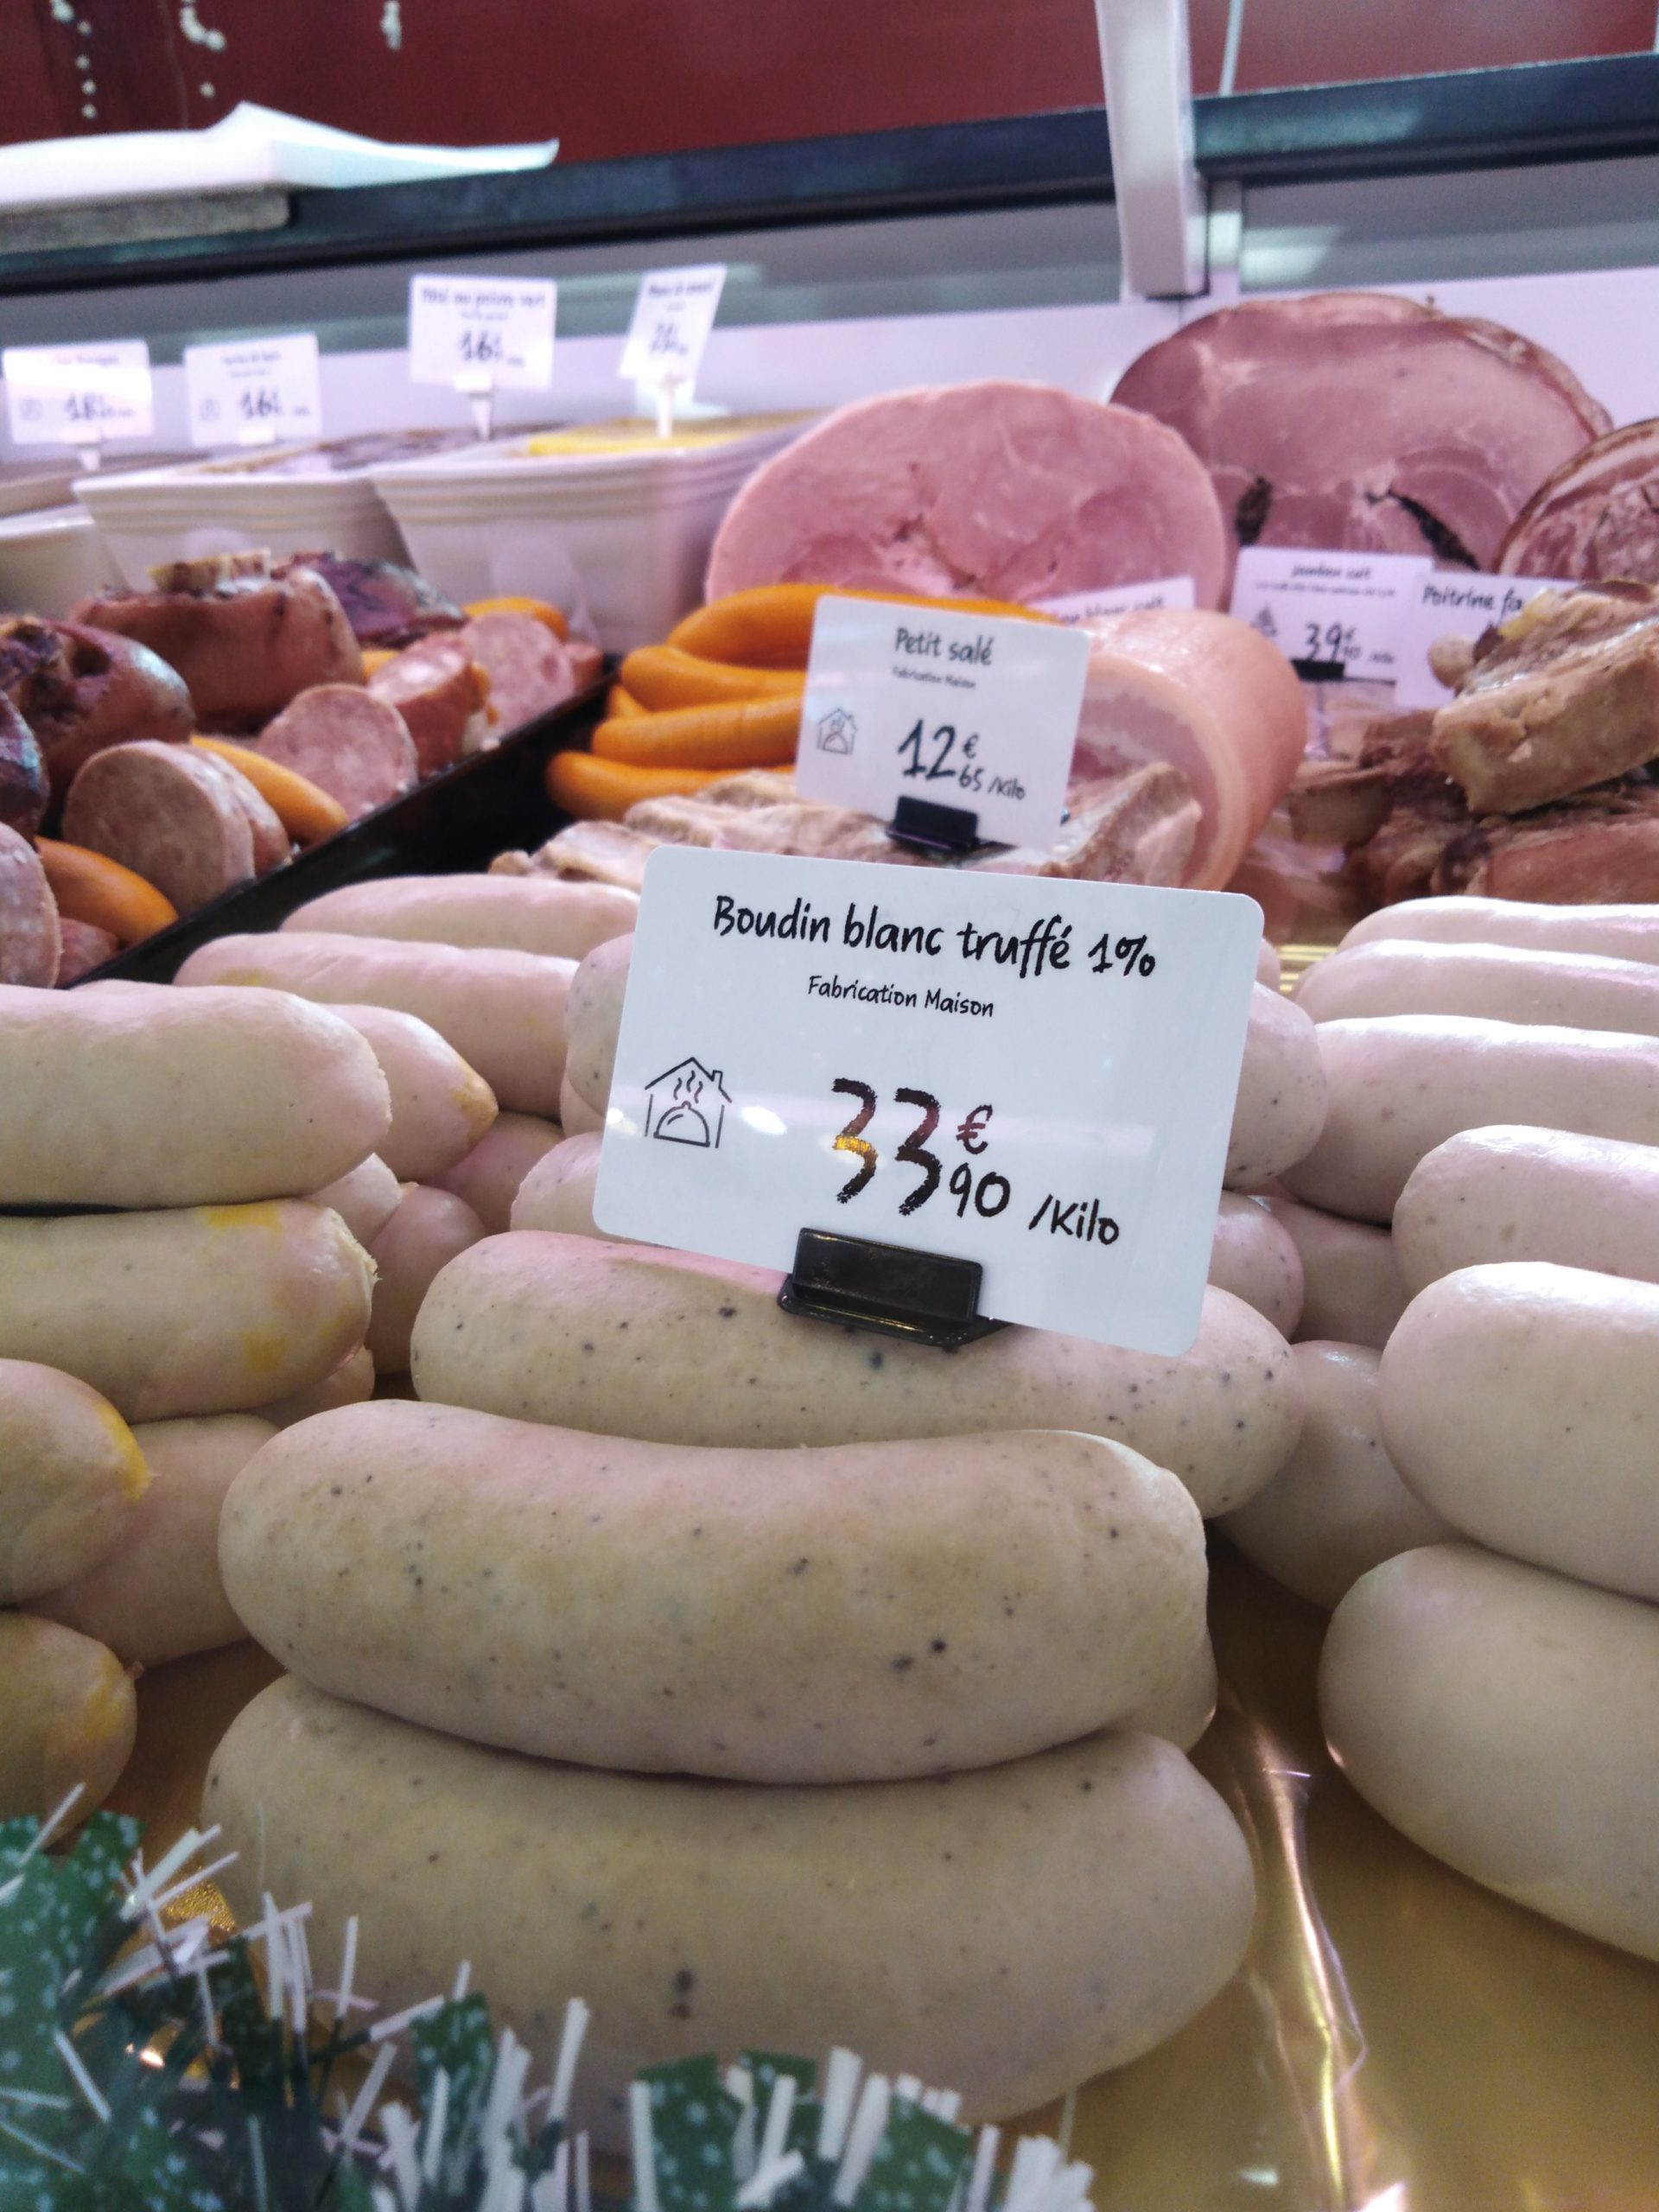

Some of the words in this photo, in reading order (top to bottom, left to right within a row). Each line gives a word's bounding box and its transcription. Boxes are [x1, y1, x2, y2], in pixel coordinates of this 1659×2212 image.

[1423, 583, 1493, 609] Poitrine
[895, 627, 942, 657] Petit
[949, 635, 995, 665] salé
[713, 895, 830, 944] Boudin
[842, 902, 943, 957] blanc
[957, 913, 1071, 978] truffé
[1086, 932, 1156, 978] 1%
[807, 974, 918, 1009] Fabrication
[924, 987, 995, 1018] Maison
[1028, 1193, 1121, 1247] /Kilo
